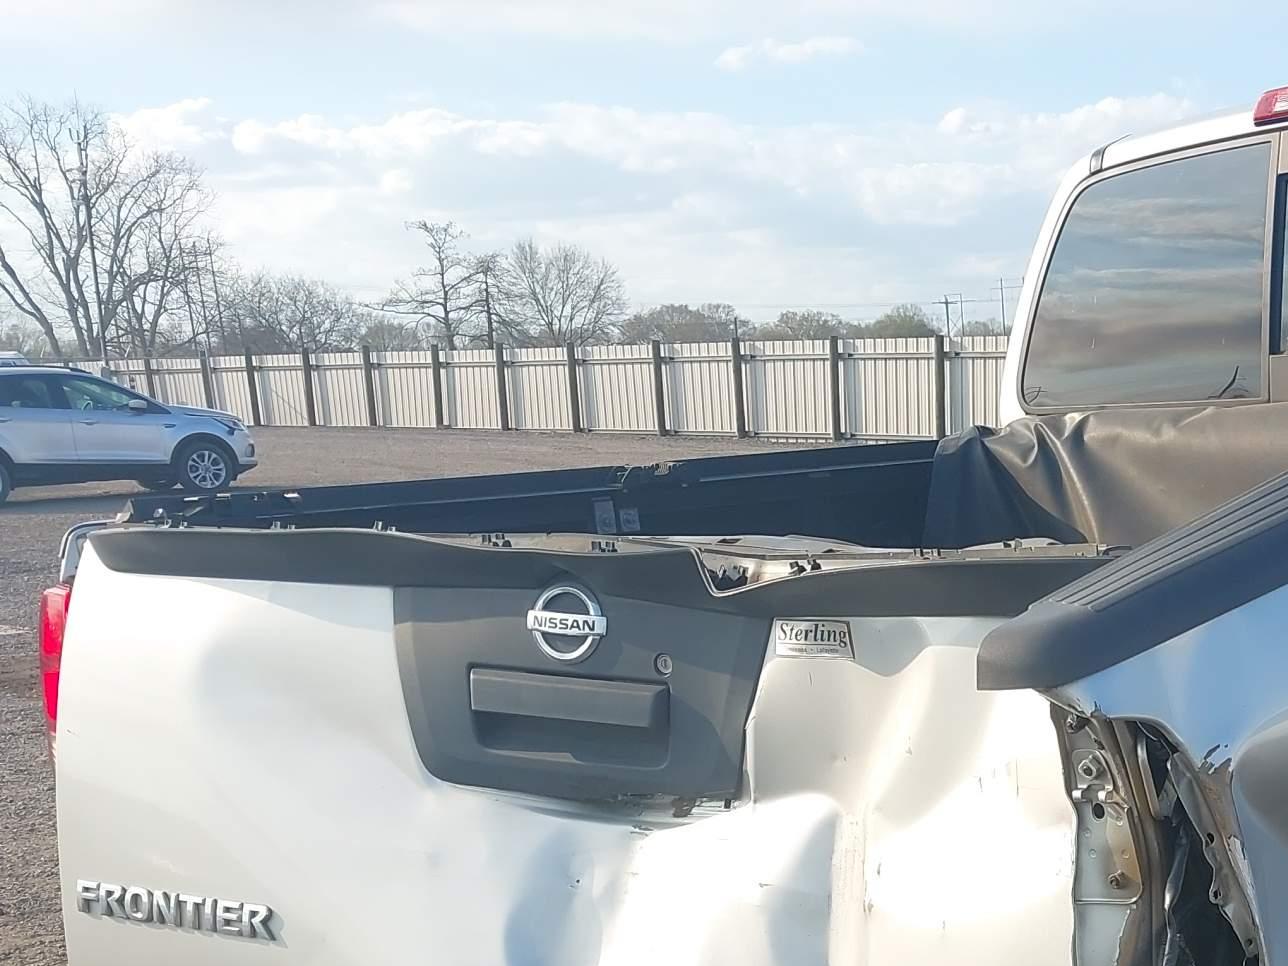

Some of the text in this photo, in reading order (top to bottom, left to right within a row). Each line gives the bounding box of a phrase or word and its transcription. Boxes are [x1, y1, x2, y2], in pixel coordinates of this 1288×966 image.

[532, 614, 596, 632] NISSAN
[778, 622, 847, 648] Sterling
[77, 879, 276, 941] FRONTIER
